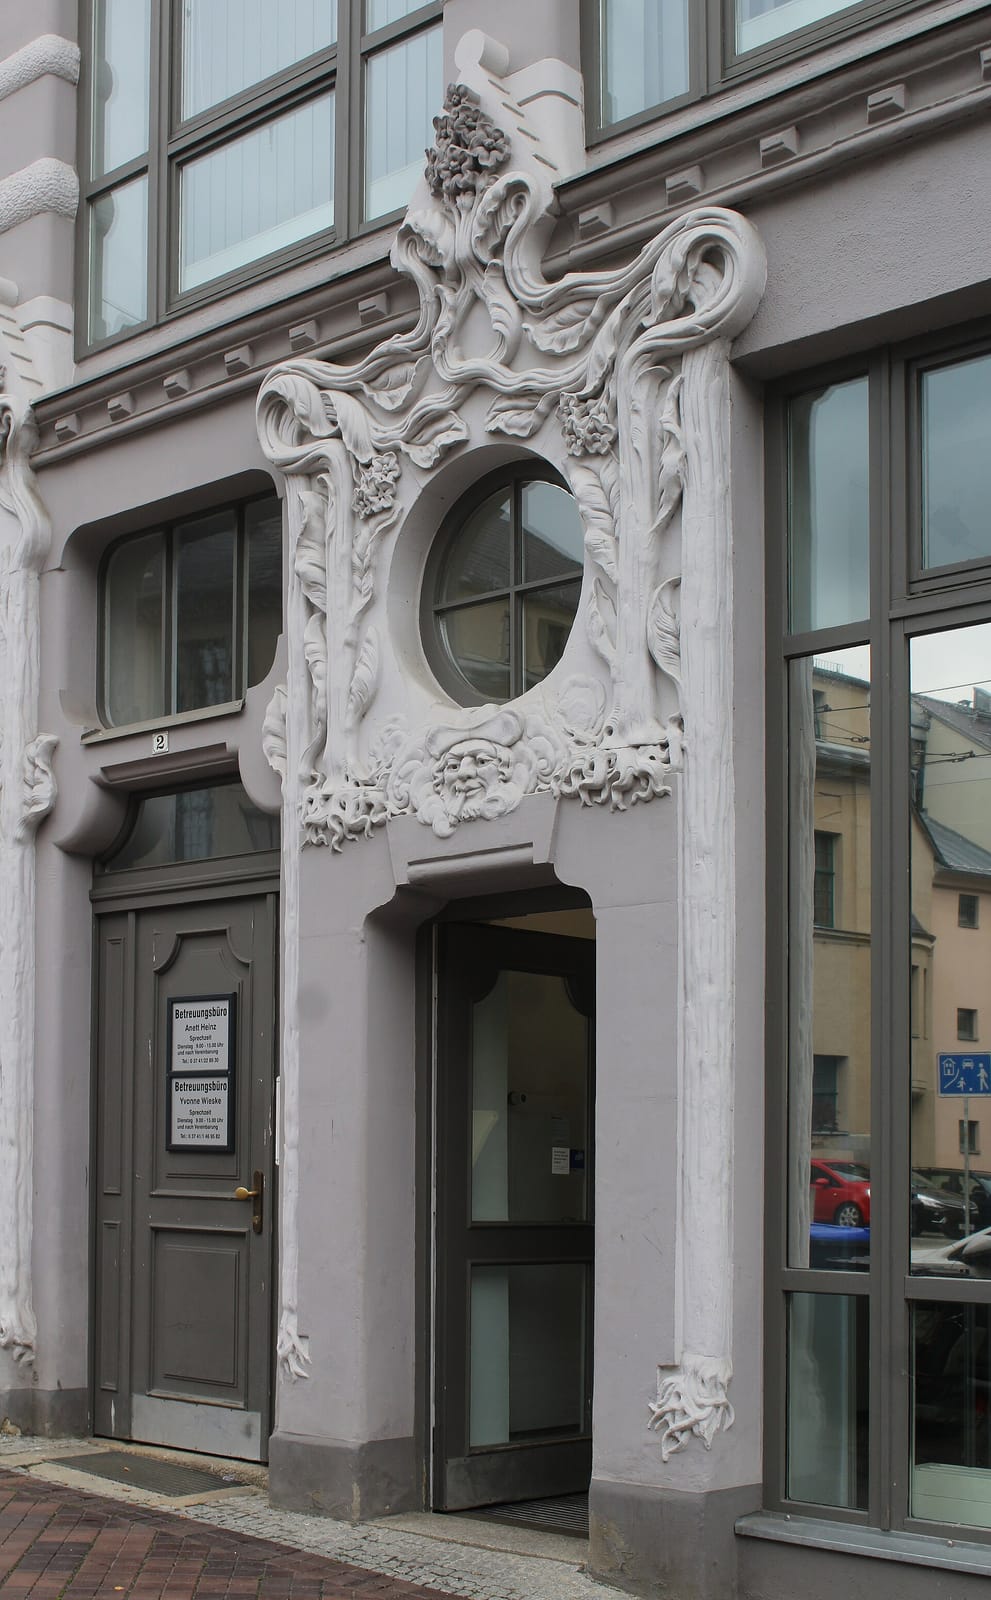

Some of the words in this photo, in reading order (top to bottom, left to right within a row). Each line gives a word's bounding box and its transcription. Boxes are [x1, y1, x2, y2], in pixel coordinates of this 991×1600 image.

[157, 735, 164, 750] 2
[175, 1006, 227, 1019] Betreuungsbüro
[175, 1081, 227, 1093] Betreuungsbüro
